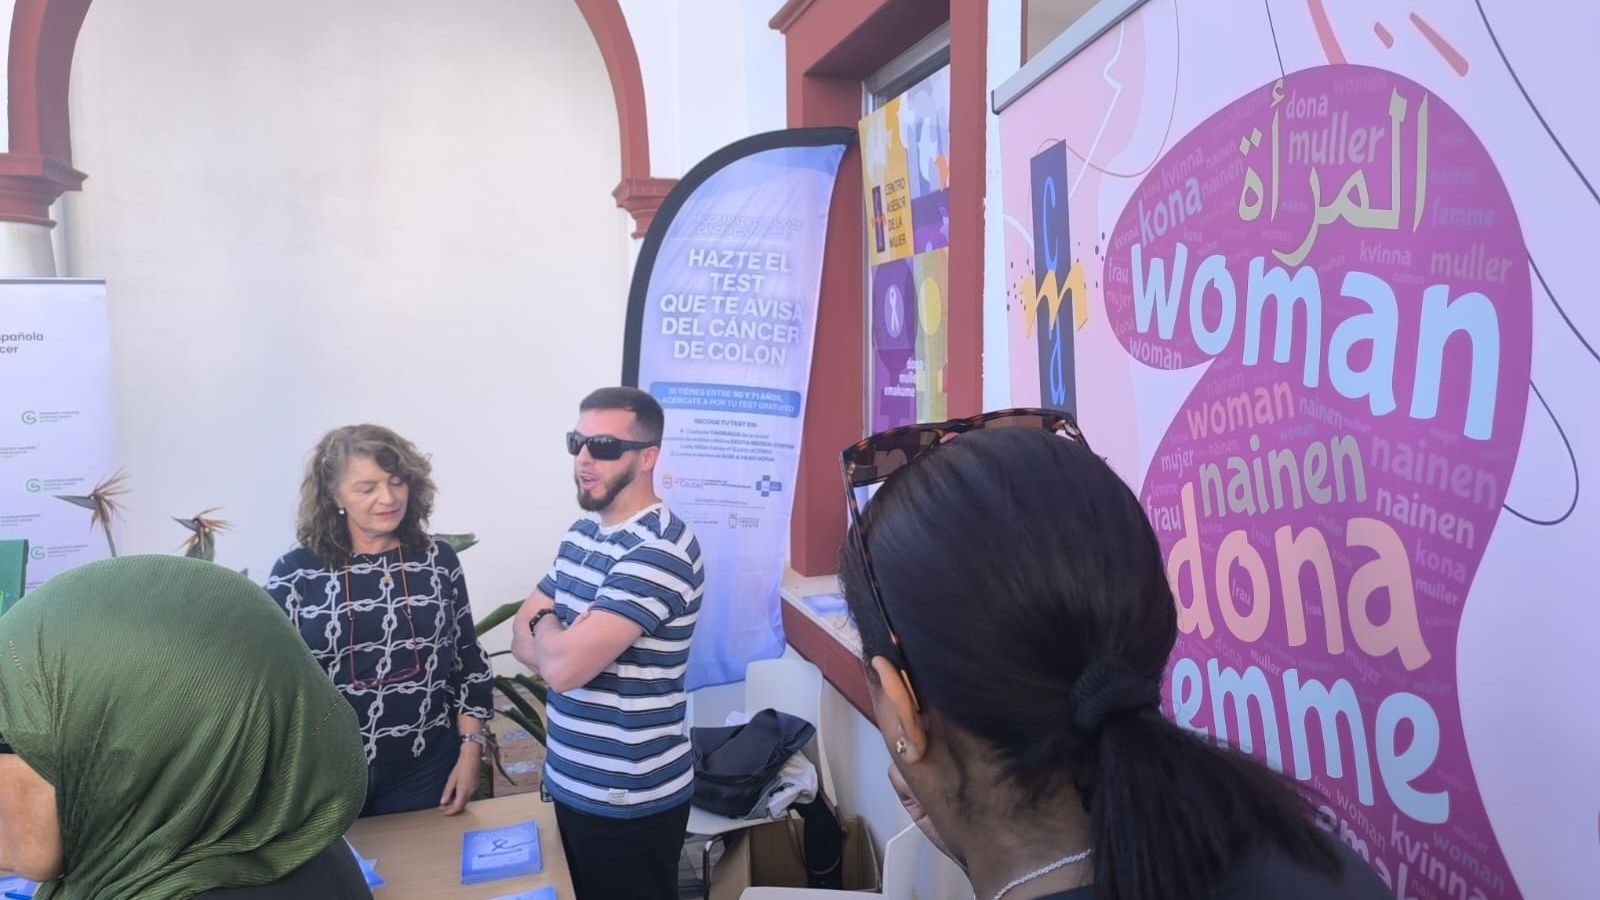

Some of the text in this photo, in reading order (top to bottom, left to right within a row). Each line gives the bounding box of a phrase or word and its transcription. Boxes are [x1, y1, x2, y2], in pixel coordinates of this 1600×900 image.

[1286, 88, 1329, 120] dona
[1287, 108, 1386, 166] muller
[1161, 145, 1205, 192] kvinna
[1138, 175, 1204, 249] kona
[1431, 196, 1495, 229] femme
[688, 248, 792, 272] HAZTE EL
[1108, 256, 1130, 285] frau
[1359, 238, 1413, 268] kvinna
[1430, 242, 1513, 284] muller
[710, 273, 766, 292] TEST
[1106, 287, 1133, 314] mujer
[660, 294, 804, 322] QUE TE AVISA
[0, 331, 44, 343] pañola
[661, 316, 800, 344] DEL CÁNCER
[1130, 241, 1500, 441] woman
[673, 340, 787, 366] DE COLON
[1129, 336, 1183, 370] woman
[1186, 380, 1296, 441] woman
[1300, 395, 1343, 431] nainen
[1160, 446, 1195, 479] mujer
[1199, 433, 1368, 519] nainen
[1370, 433, 1498, 511] nainen
[1146, 495, 1183, 533] frau
[1376, 487, 1476, 550] nainen
[1167, 481, 1433, 672] dona
[1414, 537, 1467, 585] kona
[1415, 576, 1460, 607] muller
[1214, 632, 1243, 669] dona
[1250, 648, 1282, 677] muller
[1345, 648, 1382, 685] mujer
[1171, 656, 1450, 824] emme
[1336, 787, 1386, 853] woman
[1433, 829, 1506, 895] woman
